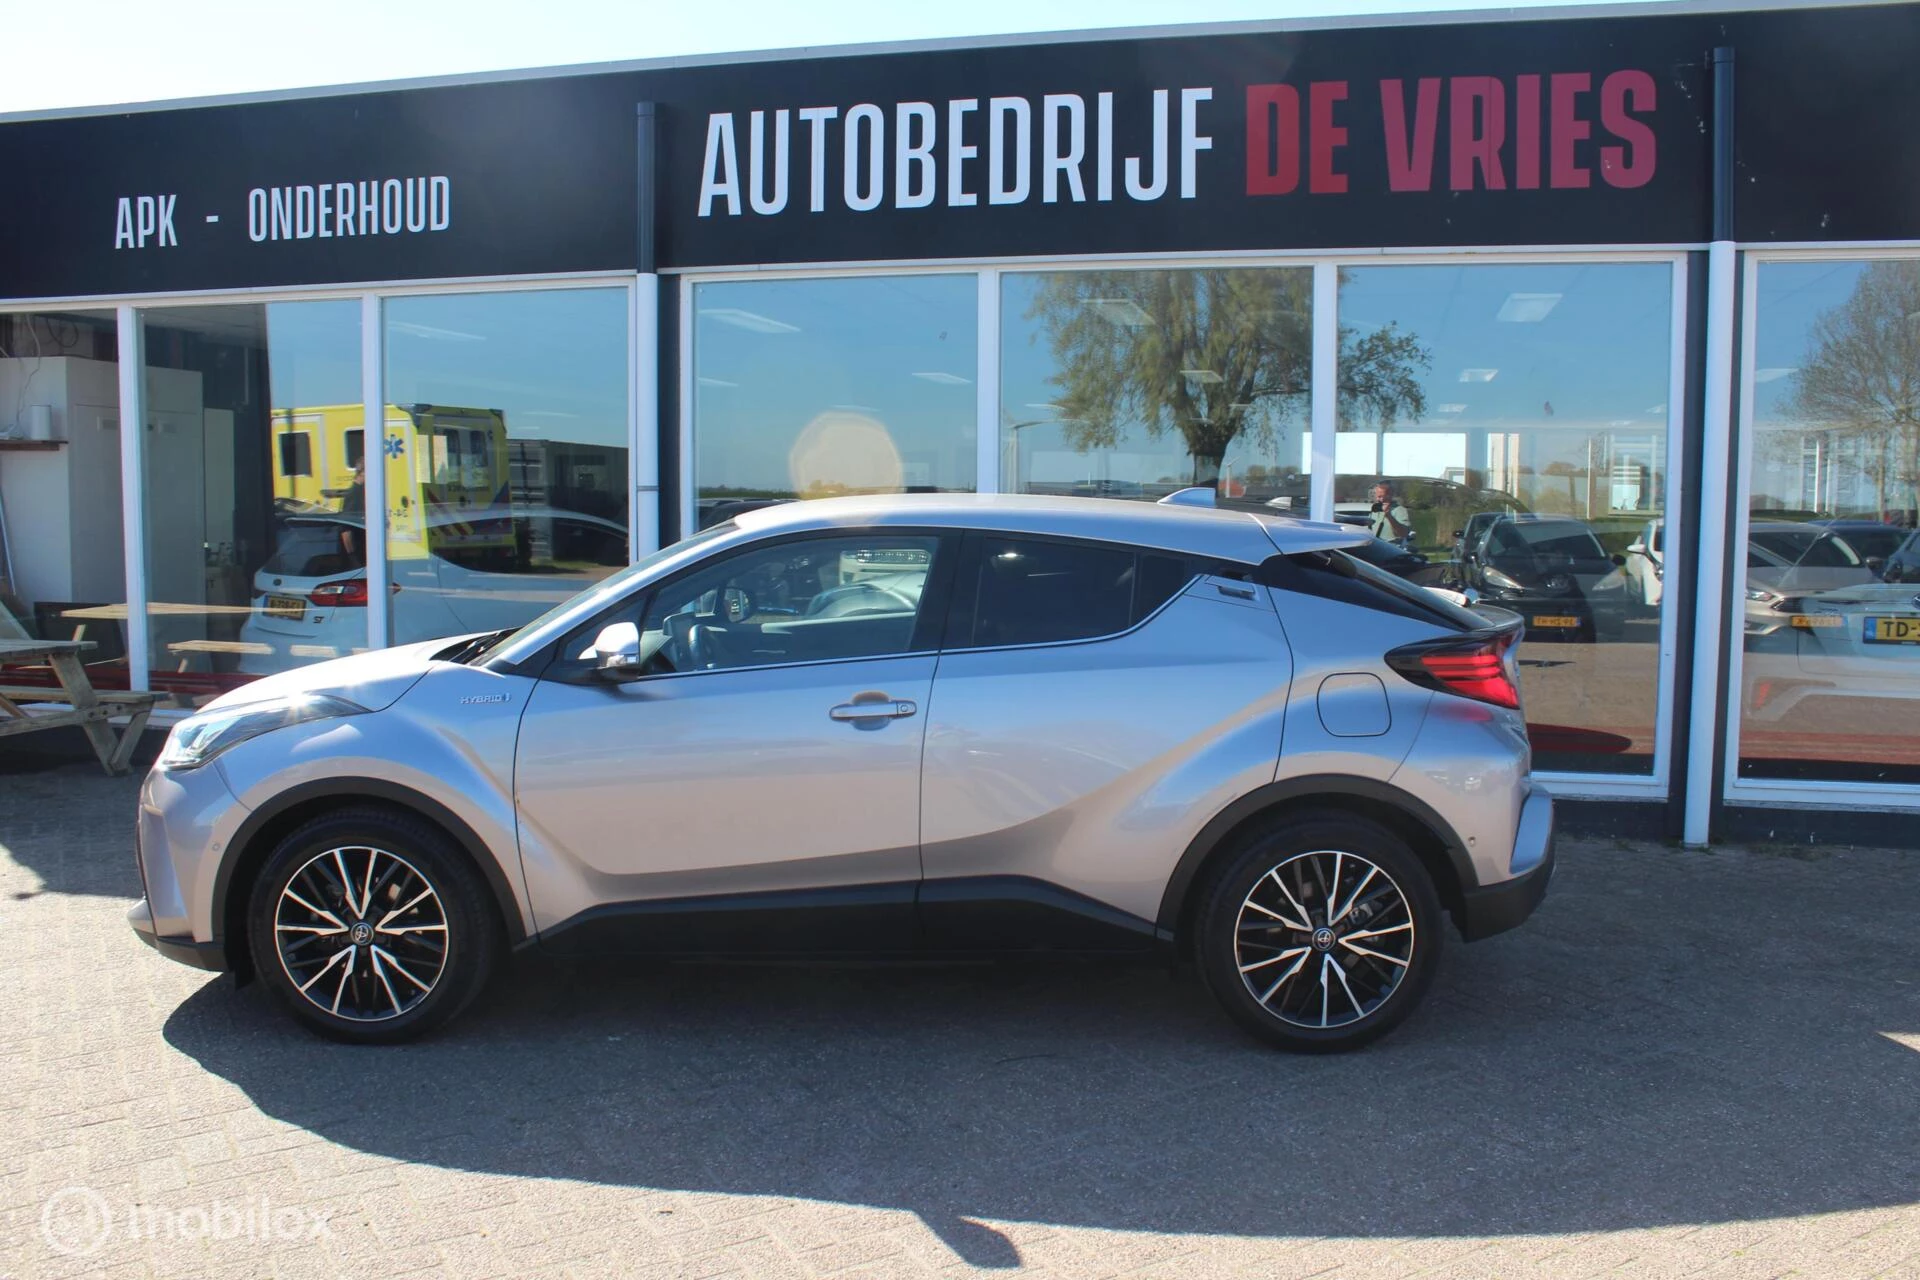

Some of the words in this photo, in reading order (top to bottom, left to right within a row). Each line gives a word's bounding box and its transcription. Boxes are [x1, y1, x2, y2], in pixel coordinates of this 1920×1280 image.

[697, 87, 1214, 218] AUTOBEDRIJF
[1246, 80, 1349, 196] DE
[1380, 69, 1658, 193] VRIES
[114, 193, 179, 250] APK
[248, 175, 451, 243] ONDERHOUD
[1883, 621, 1920, 638] TD-
[459, 694, 503, 704] HYBRID
